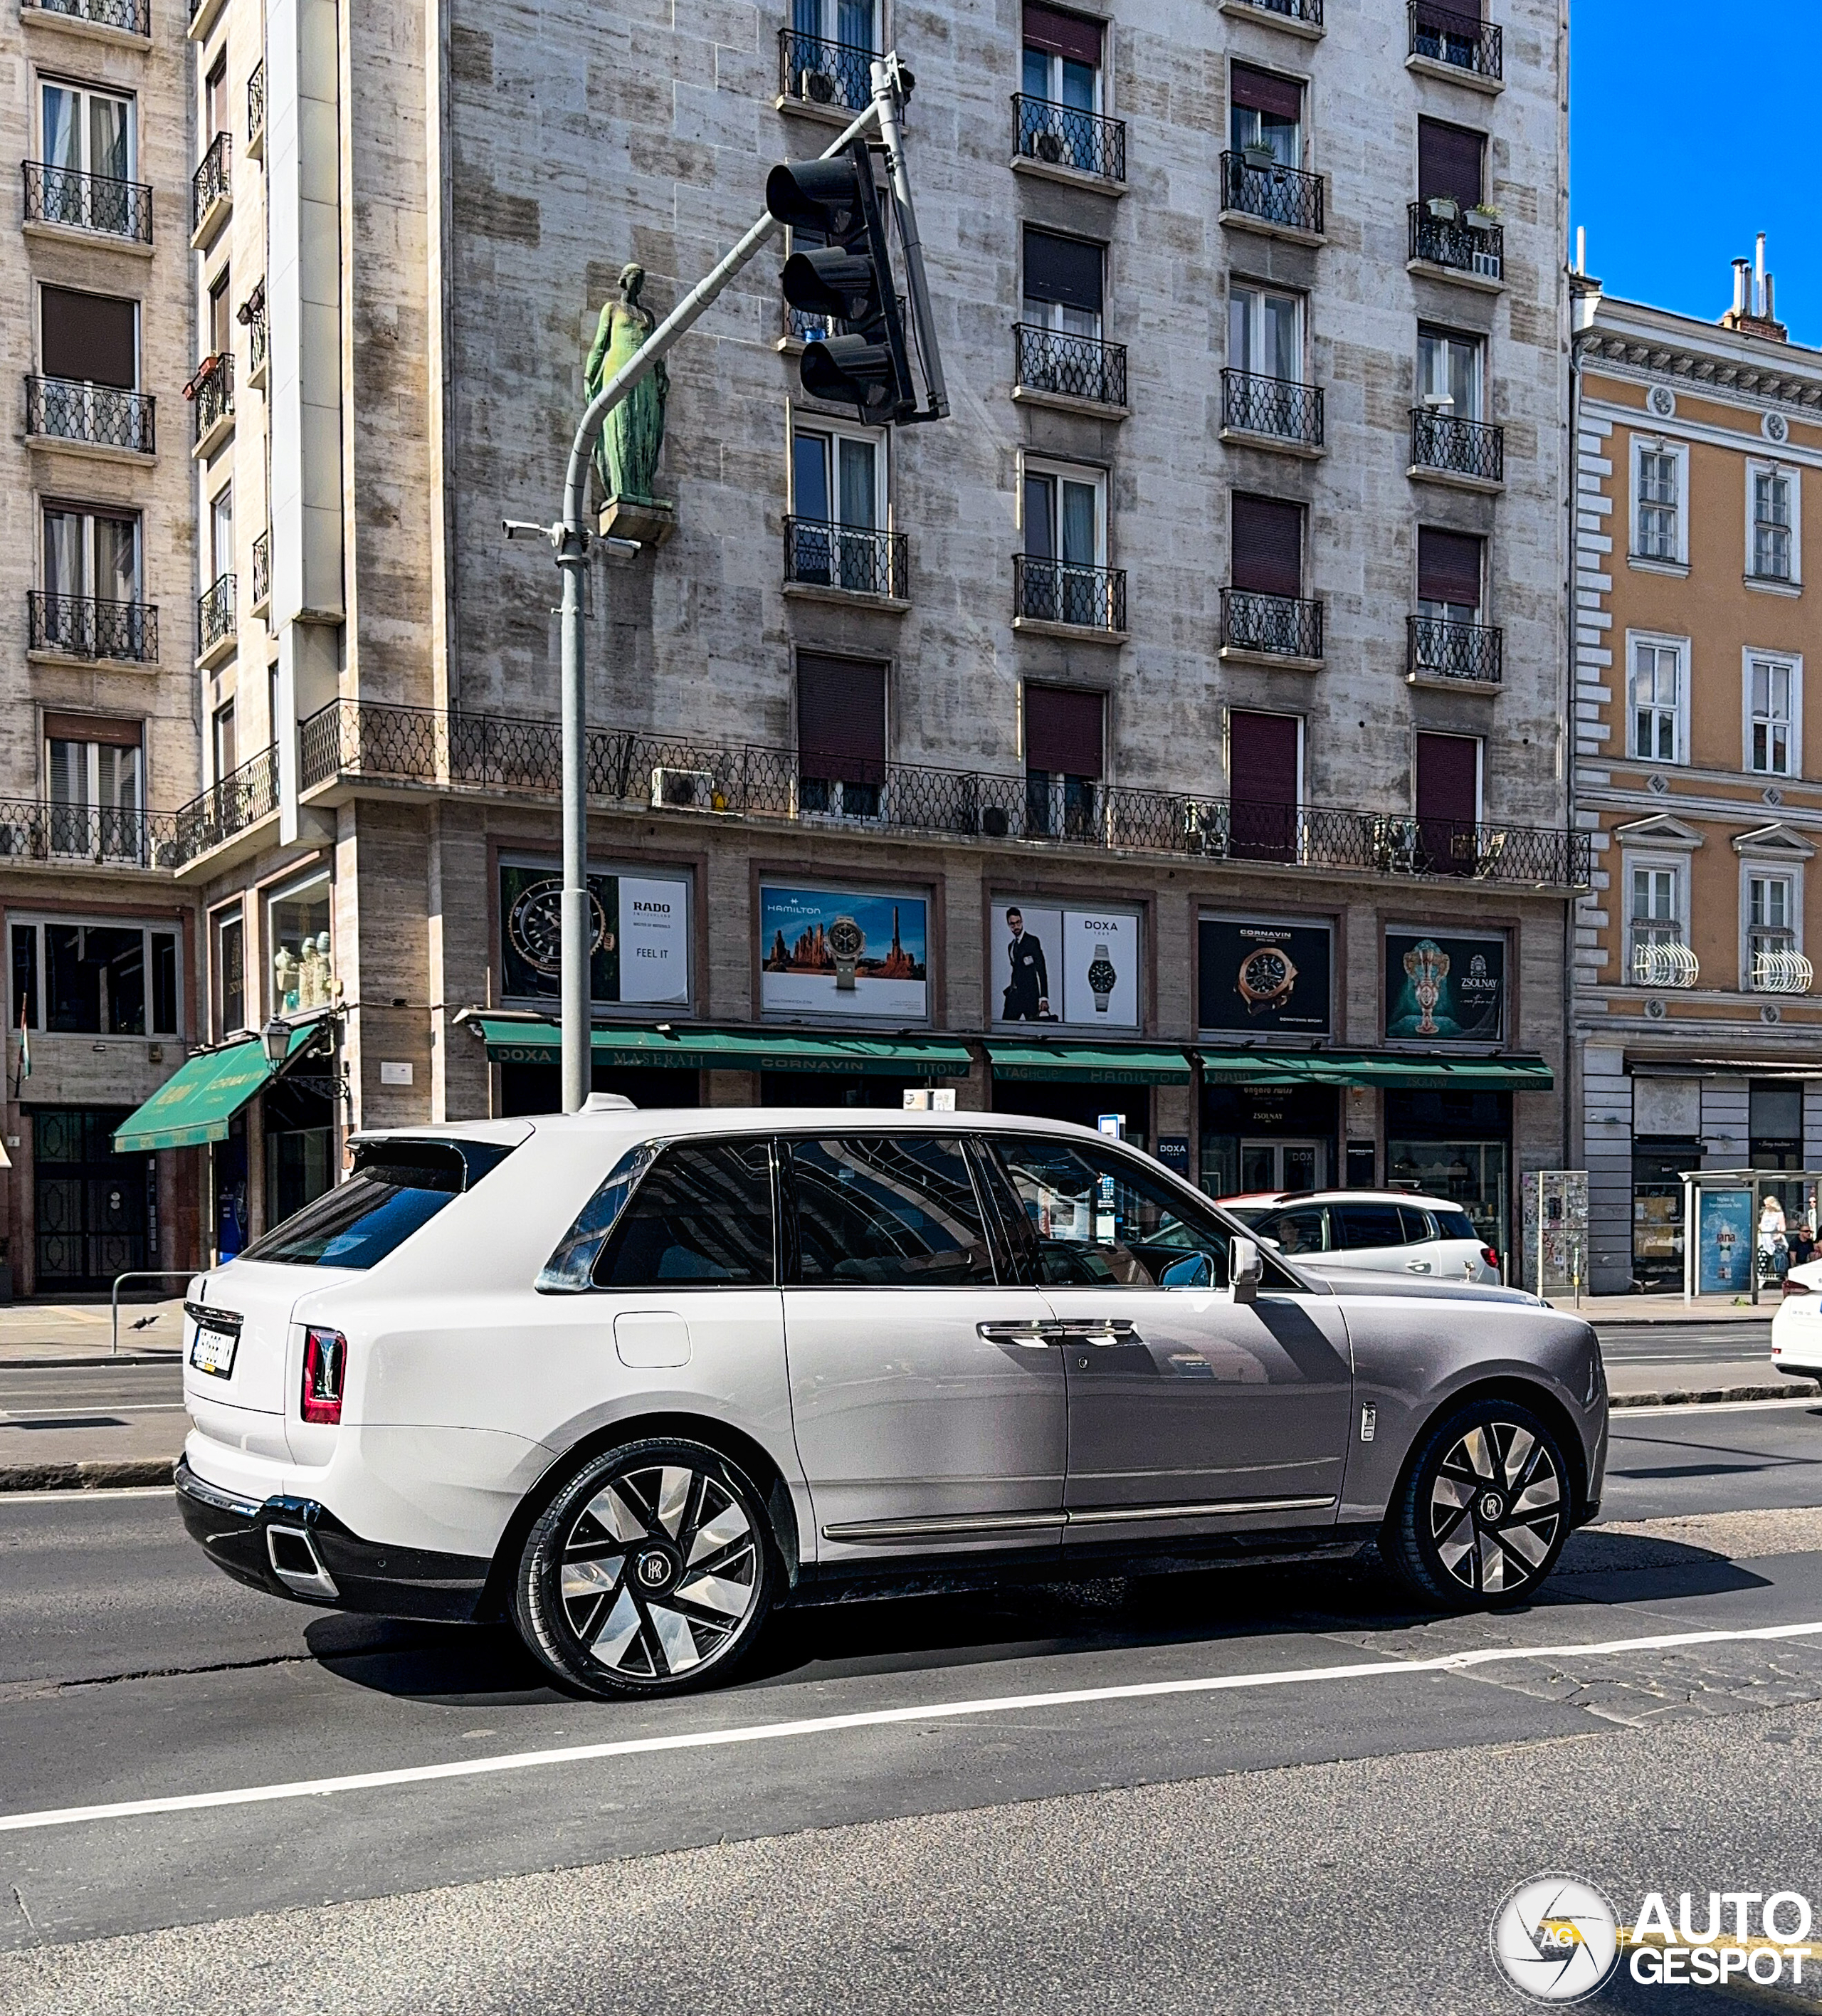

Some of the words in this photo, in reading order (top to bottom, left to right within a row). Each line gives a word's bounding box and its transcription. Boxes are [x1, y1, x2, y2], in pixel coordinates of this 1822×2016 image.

[633, 901, 670, 913] RADO
[767, 905, 821, 914] HAMILTON
[1085, 920, 1118, 931] DOXA
[1240, 929, 1291, 938] CORNAVIN
[636, 947, 657, 958] FEEL
[660, 950, 668, 959] IT
[1461, 977, 1497, 988] ZSOLNAY
[498, 1049, 552, 1061] DOXA
[614, 1052, 705, 1066] MASERATI
[762, 1059, 863, 1070] CORNAVIN
[1292, 1152, 1313, 1161] DOX
